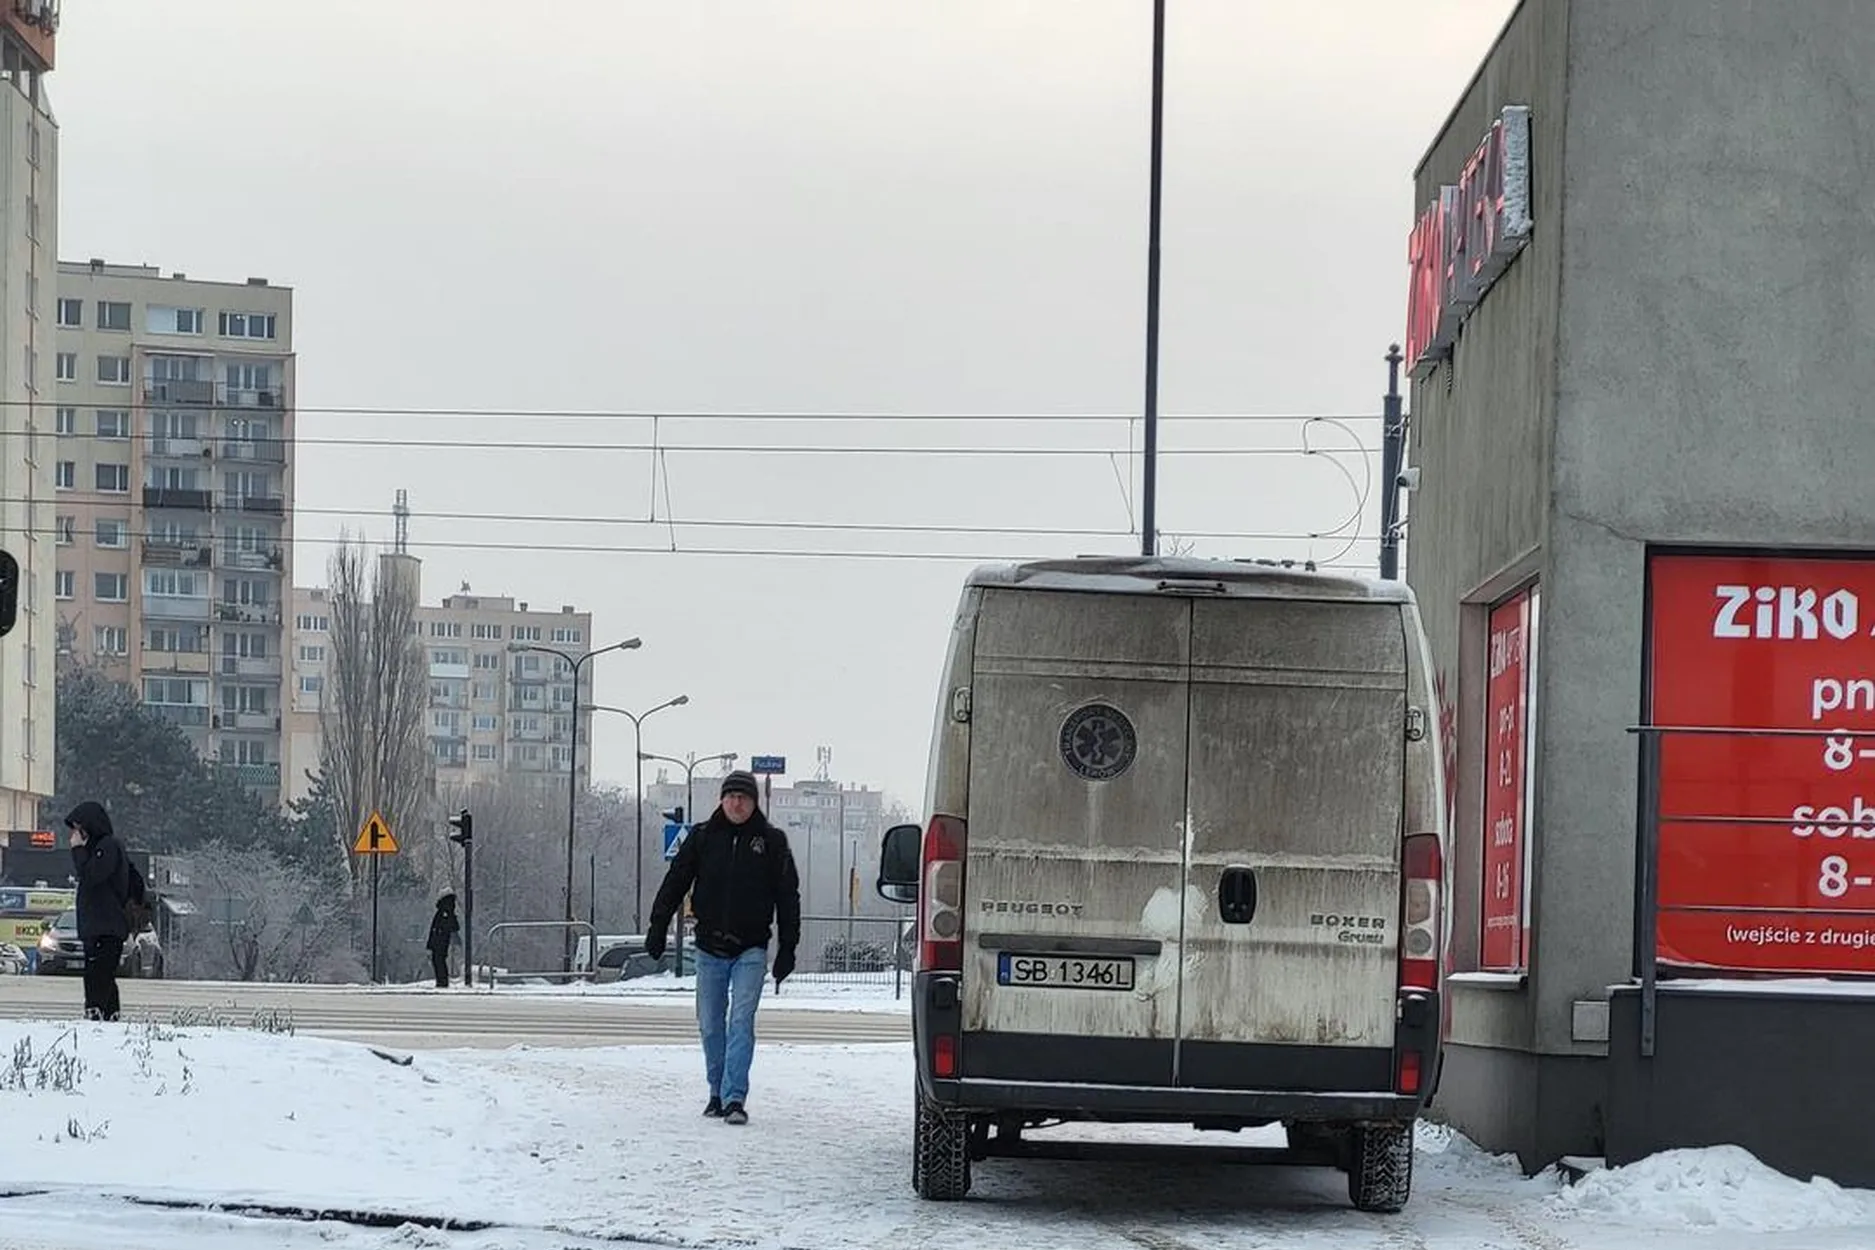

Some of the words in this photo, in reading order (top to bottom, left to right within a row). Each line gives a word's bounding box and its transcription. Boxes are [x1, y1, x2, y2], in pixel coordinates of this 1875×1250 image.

[981, 902, 1083, 916] PEUGEOT
[1311, 914, 1385, 929] BOXER
[1726, 924, 1800, 945] (wejście
[1805, 931, 1816, 943] z
[1015, 959, 1048, 982] SB
[1059, 961, 1129, 985] 1346L
